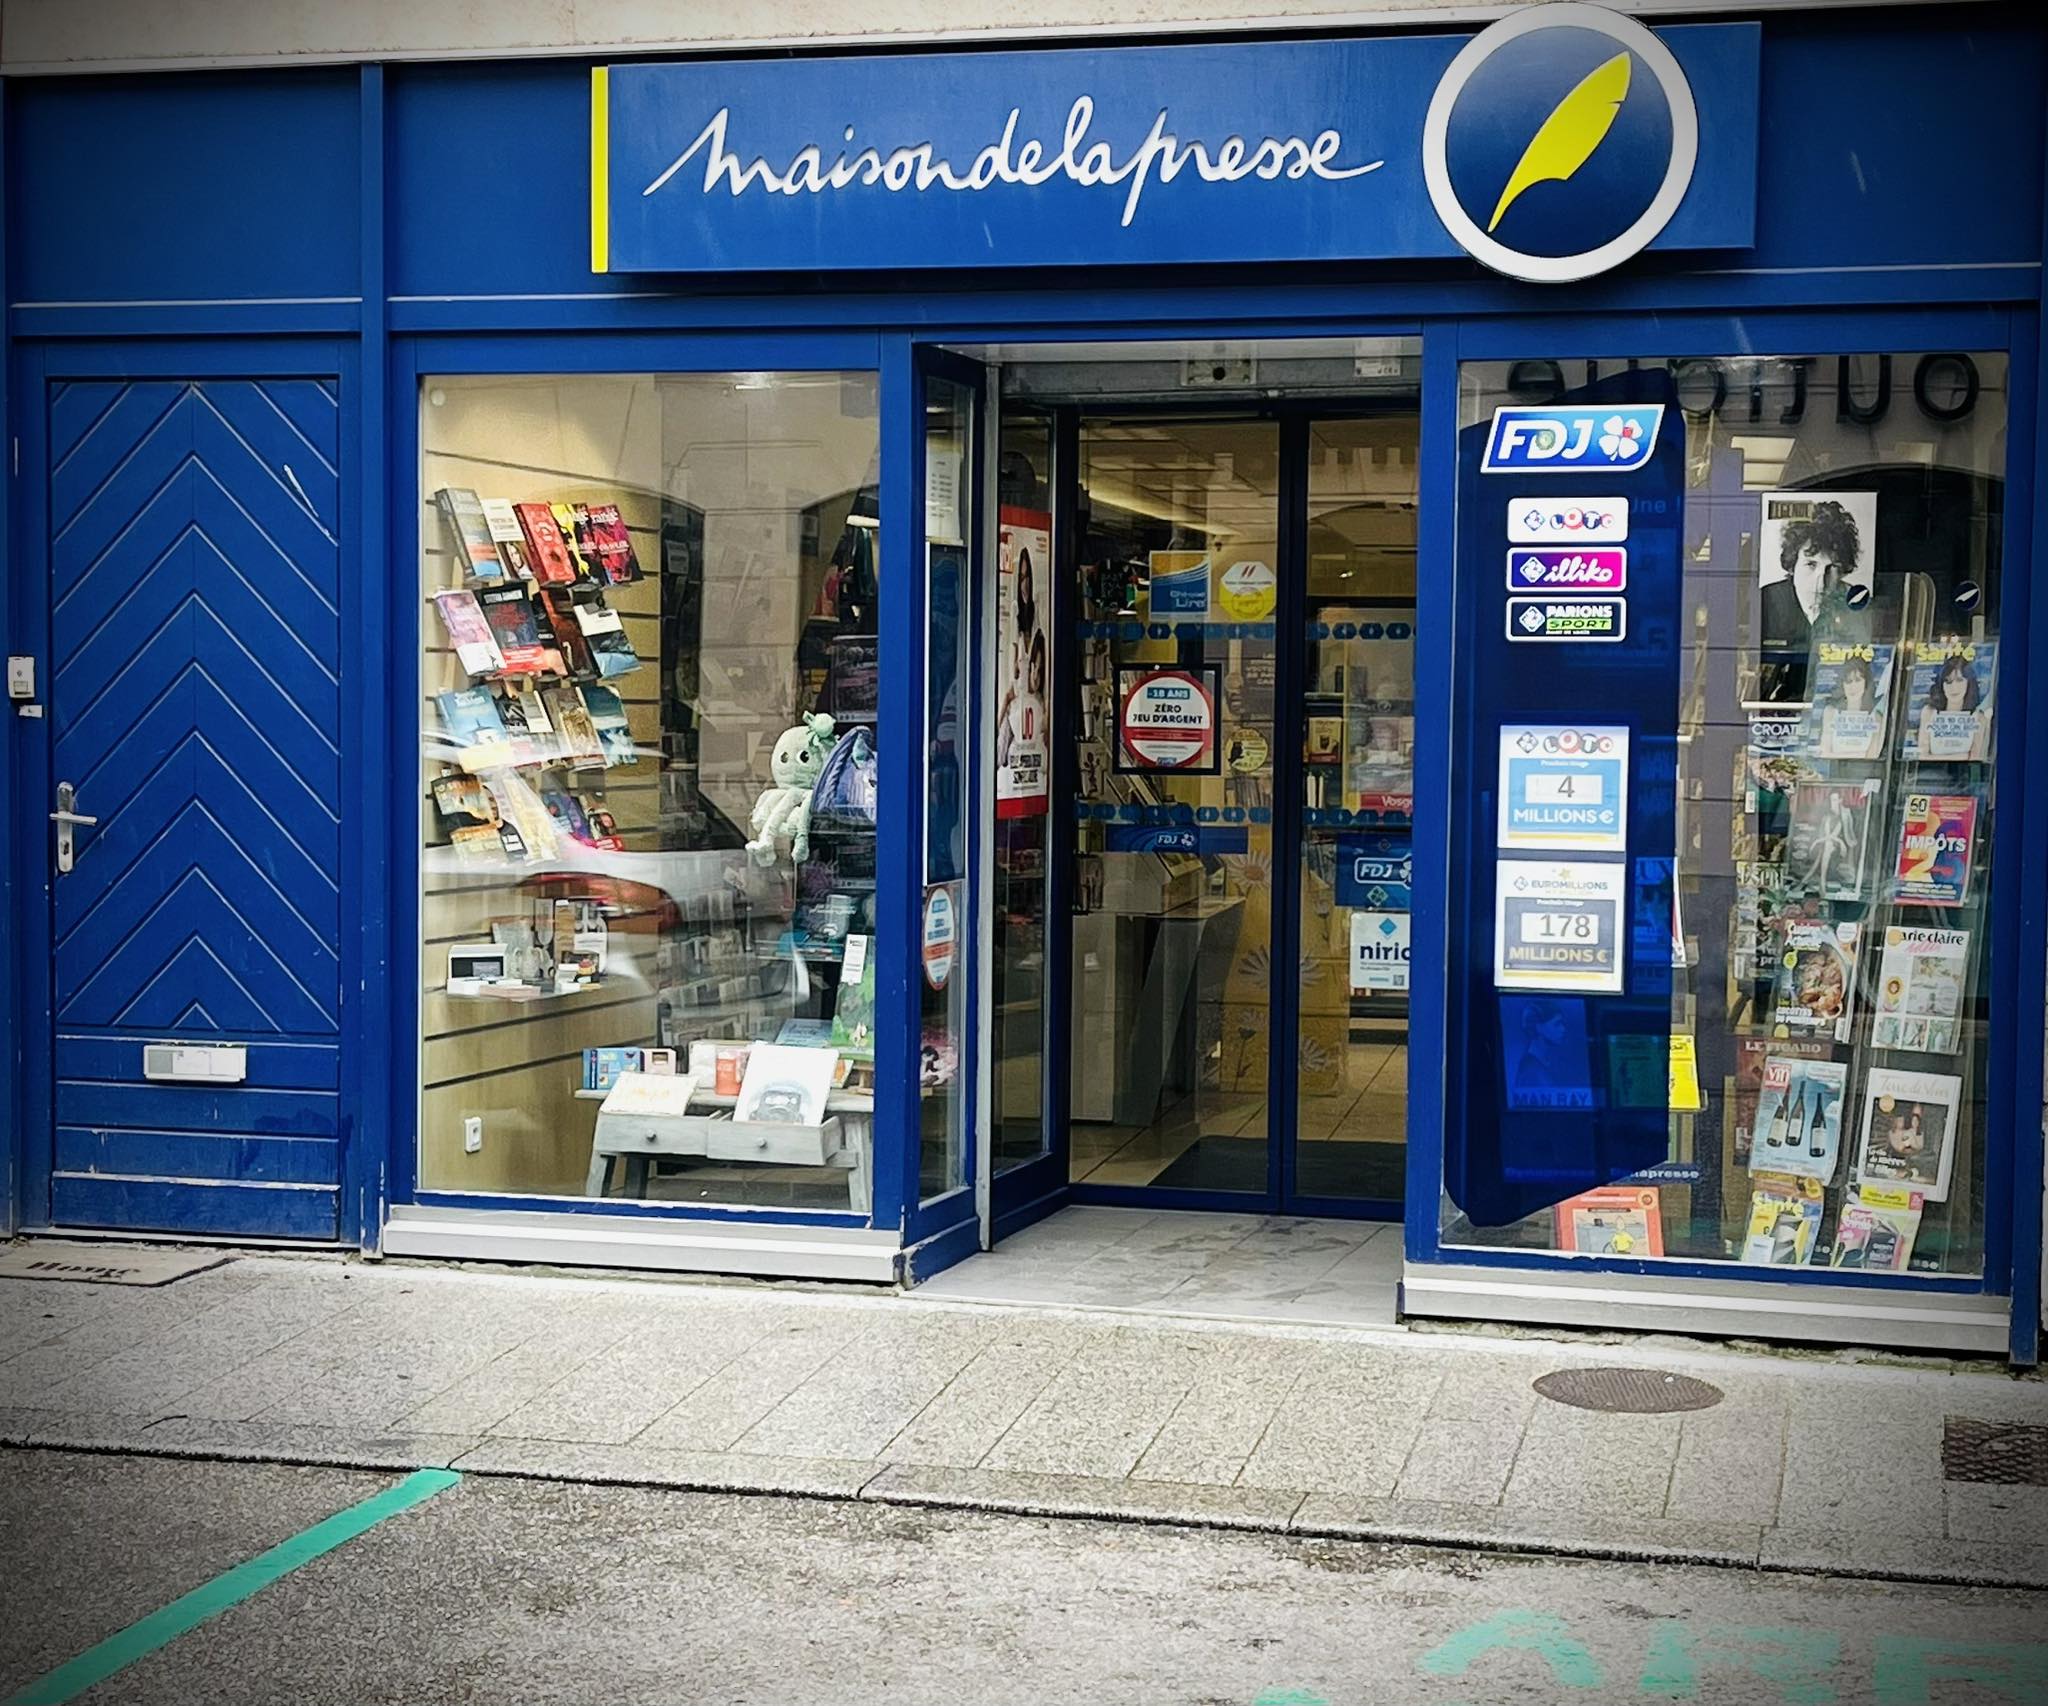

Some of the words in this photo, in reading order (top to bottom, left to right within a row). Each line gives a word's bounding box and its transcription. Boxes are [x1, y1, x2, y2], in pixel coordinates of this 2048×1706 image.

[1497, 418, 1594, 460] FDJ
[1549, 507, 1615, 531] LOTO
[1543, 556, 1613, 583] illiko
[1545, 605, 1613, 618] PARIONS
[1549, 620, 1608, 629] SPORT
[1154, 702, 1182, 713] ZÉRO
[1133, 713, 1150, 723] JEU
[1153, 713, 1203, 724] D'ARGENT
[1543, 729, 1613, 754] LOTO
[1557, 775, 1575, 799] 4
[1381, 795, 1412, 808] Vosg
[1910, 798, 1928, 813] 60
[1513, 808, 1597, 823] MILLIONS
[1157, 833, 1178, 845] FDJ
[1905, 833, 1967, 852] IMPÔTS
[1359, 864, 1392, 878] FDJ
[1531, 880, 1608, 890] EUROMILLIONS
[1539, 914, 1591, 938] 178
[1900, 929, 1926, 942] arie
[1927, 931, 1965, 945] claire
[1508, 946, 1594, 963] MILLIONS
[1745, 1041, 1764, 1052] LE
[1766, 1043, 1821, 1053] FIGARO
